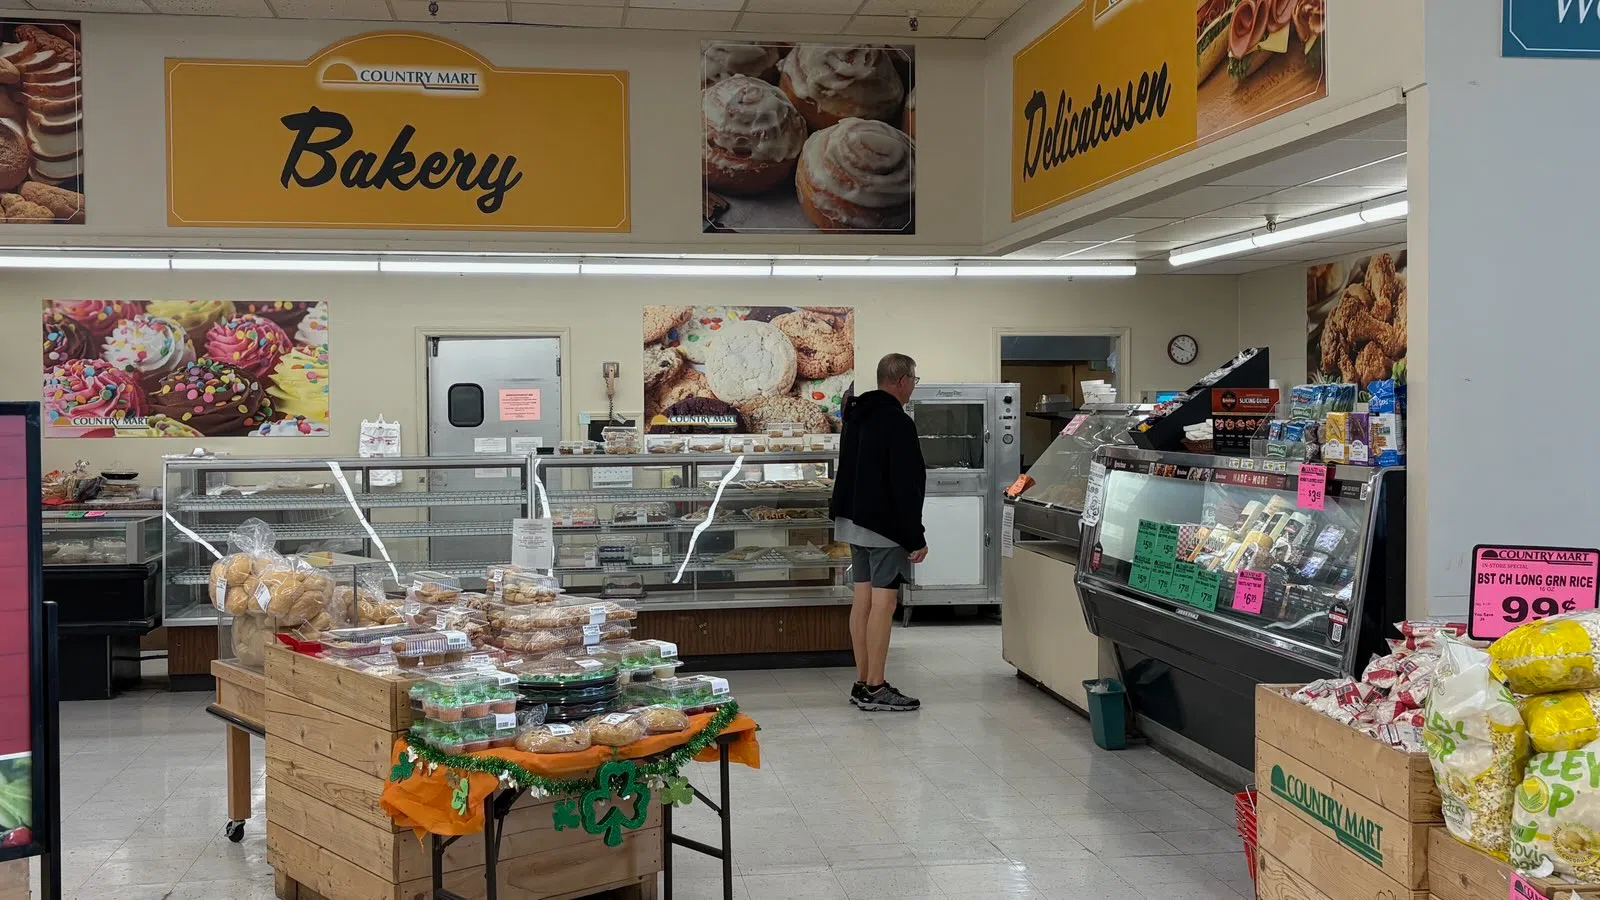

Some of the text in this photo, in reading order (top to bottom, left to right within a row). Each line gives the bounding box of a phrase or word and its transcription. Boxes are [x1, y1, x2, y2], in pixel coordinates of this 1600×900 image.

[1557, 0, 1600, 23] W
[360, 70, 478, 85] COUNTRY MART
[1023, 61, 1172, 183] Delicatessen
[280, 105, 523, 214] Bakery
[73, 416, 149, 426] COUNTRY MART
[669, 415, 737, 423] COUNTRY MART
[1499, 549, 1590, 562] COUNTRY MART
[1477, 573, 1593, 588] BST CH LONG GRN RICE
[1287, 774, 1343, 828] COUNTRY
[1345, 807, 1383, 851] MART
